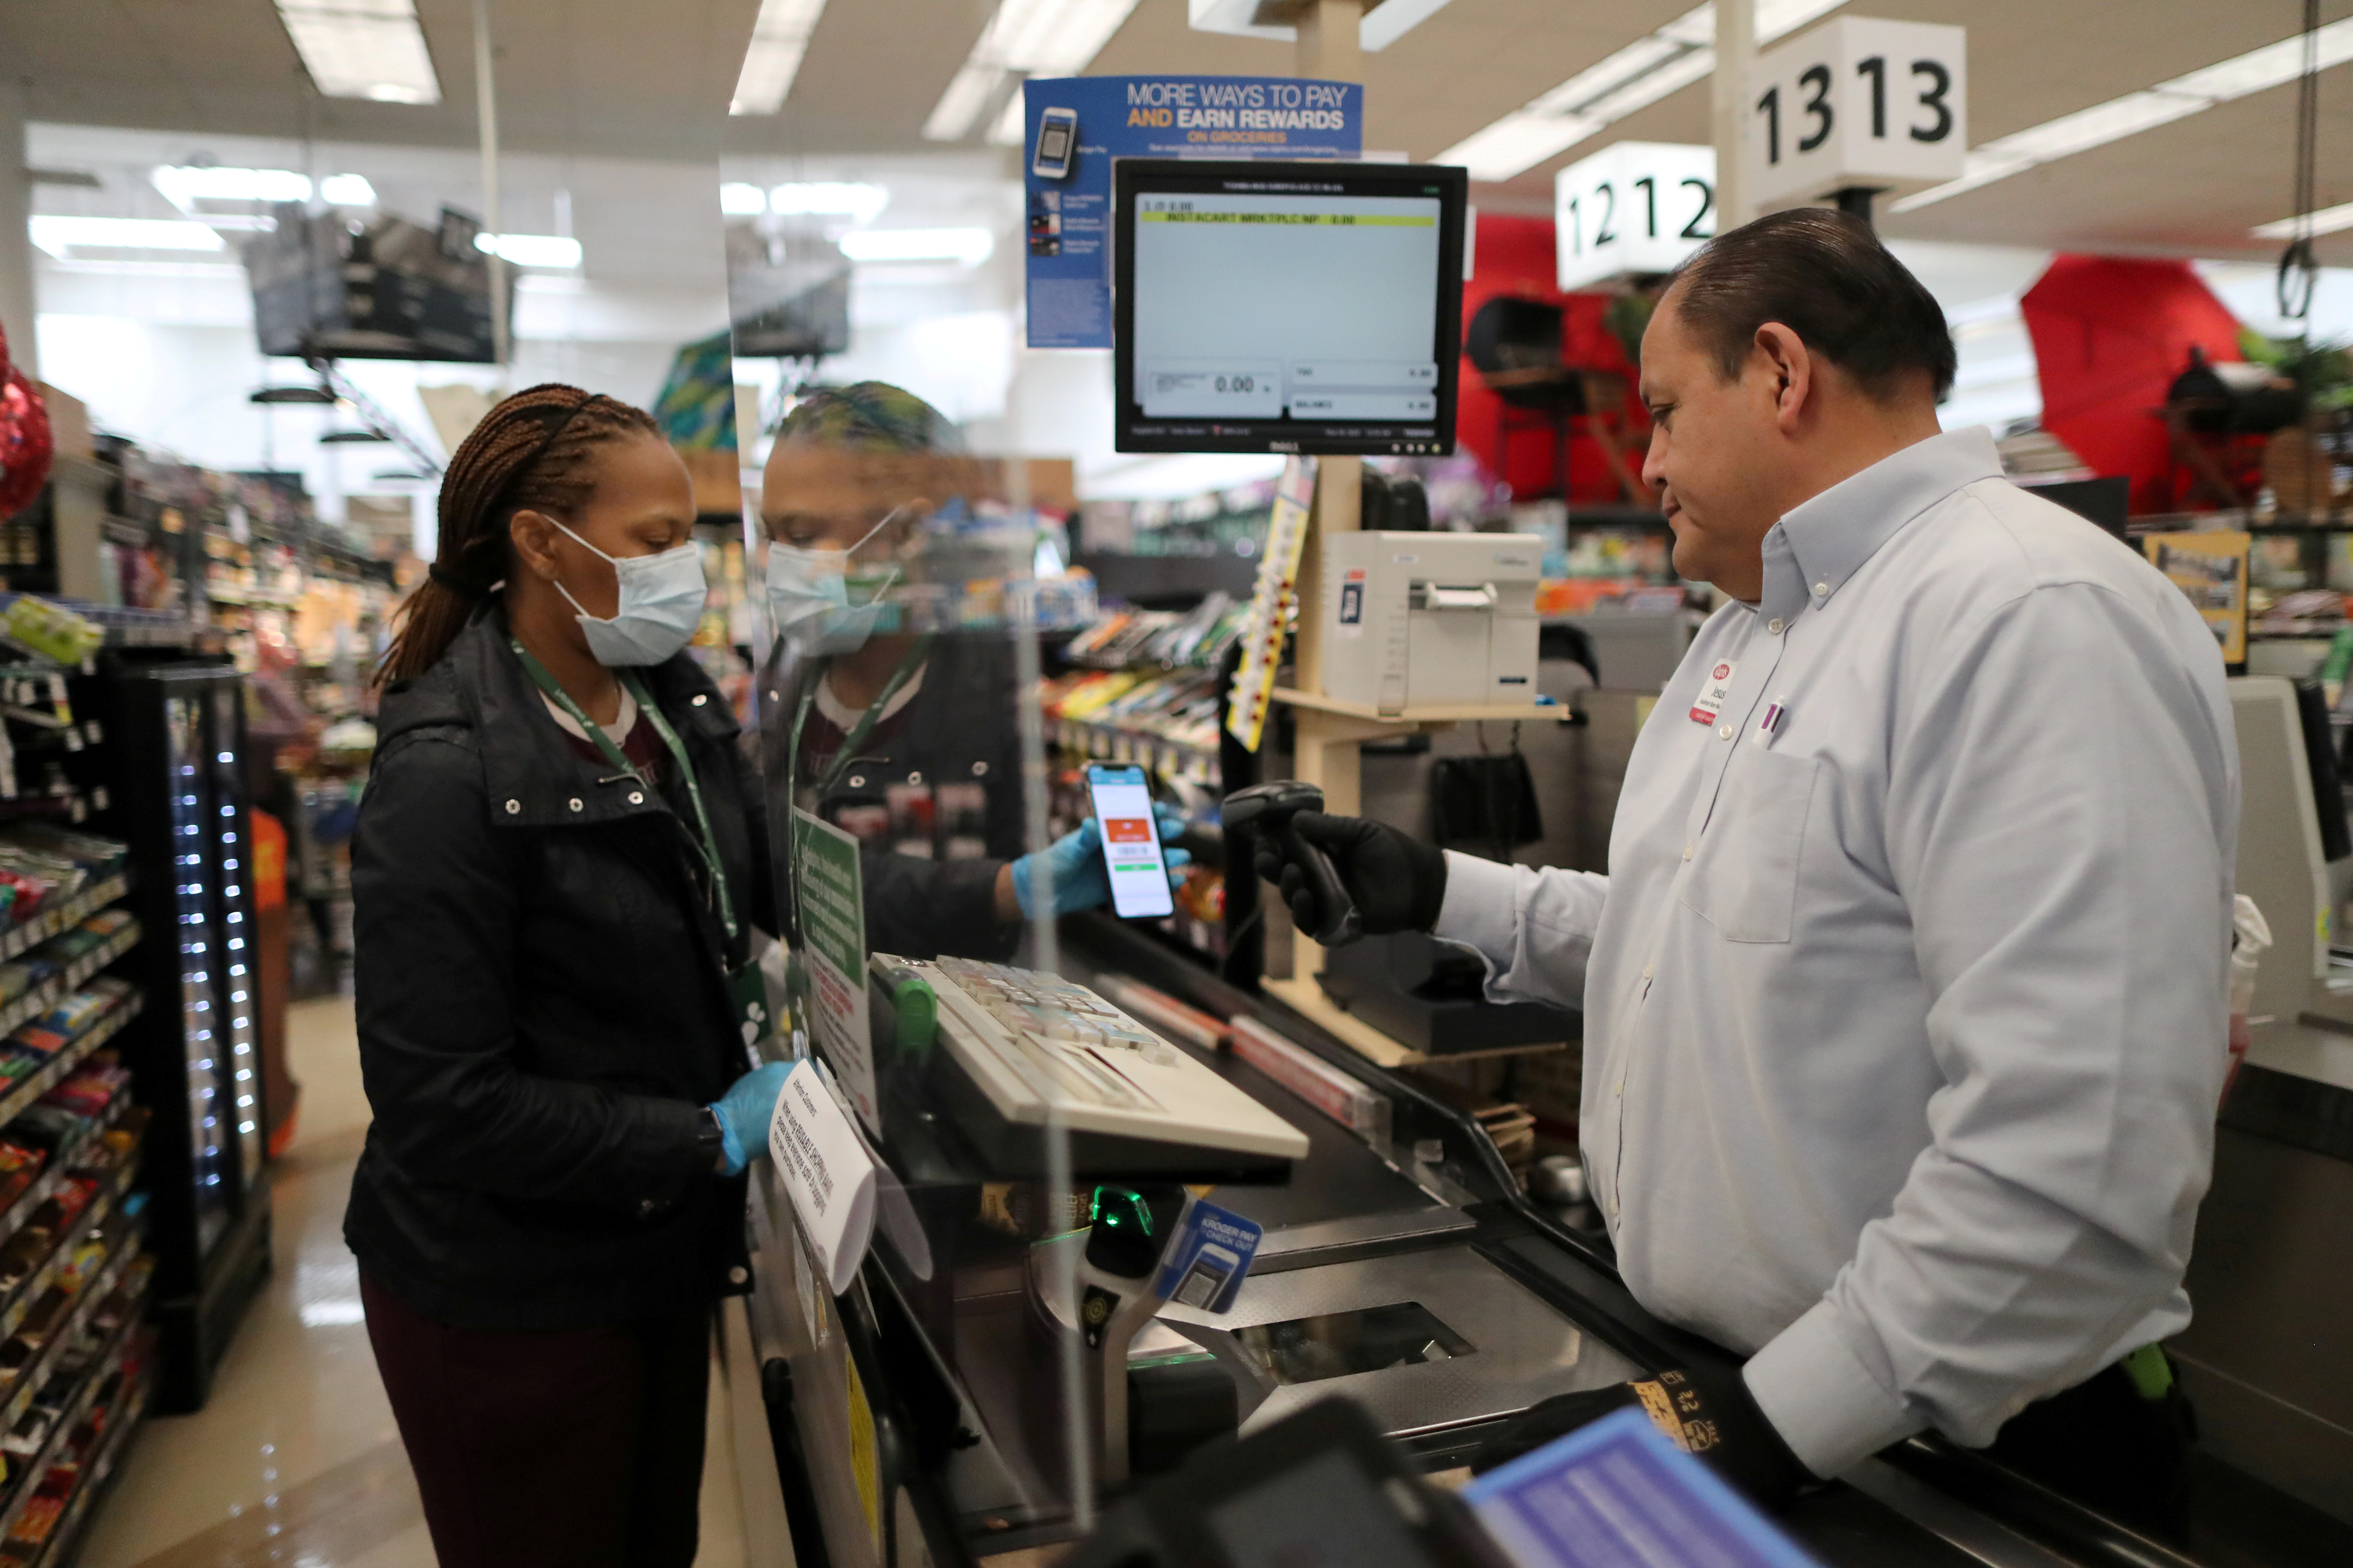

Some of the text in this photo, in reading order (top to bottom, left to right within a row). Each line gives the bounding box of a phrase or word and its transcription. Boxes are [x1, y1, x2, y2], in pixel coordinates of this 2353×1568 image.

[1127, 83, 1348, 108] MORE WAYS TO PAY
[1857, 55, 1953, 142] 13
[1127, 109, 1344, 130] AND EARN REWARDS
[1757, 64, 1834, 165] 13
[1188, 131, 1286, 143] ON GROCERIES
[1167, 212, 1236, 223] INSTACART
[1570, 182, 1617, 256] 12
[1635, 177, 1714, 238] 12
[1216, 376, 1254, 393] 0.00
[793, 1077, 805, 1098] Attention
[777, 1115, 786, 1136] please
[785, 1128, 793, 1149] keep
[790, 1143, 804, 1171] everyone
[802, 1165, 812, 1182] safe
[808, 1174, 816, 1192] by
[789, 1116, 797, 1134] using
[795, 1124, 813, 1155] REUSABLE
[810, 1147, 827, 1181] SHOPPING
[1201, 1218, 1239, 1237] KROGER
[1240, 1230, 1258, 1243] PAY
